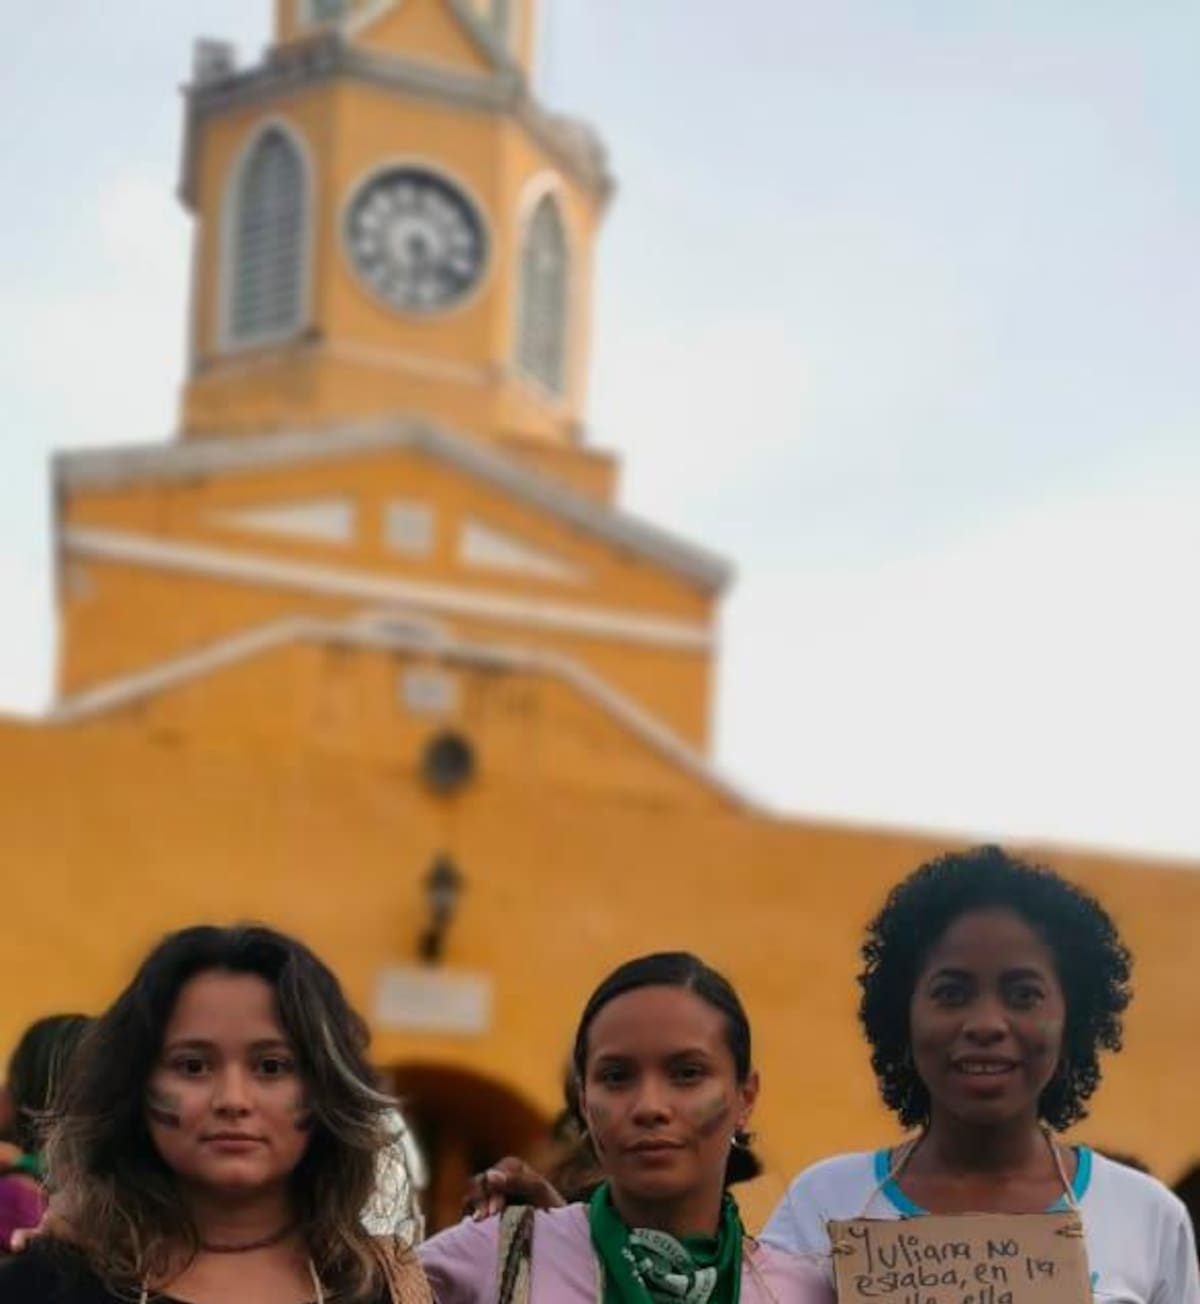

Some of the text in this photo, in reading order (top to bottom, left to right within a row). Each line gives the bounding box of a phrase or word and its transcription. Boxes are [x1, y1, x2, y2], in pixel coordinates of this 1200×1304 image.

[857, 1258, 1054, 1296] estaba, en la
